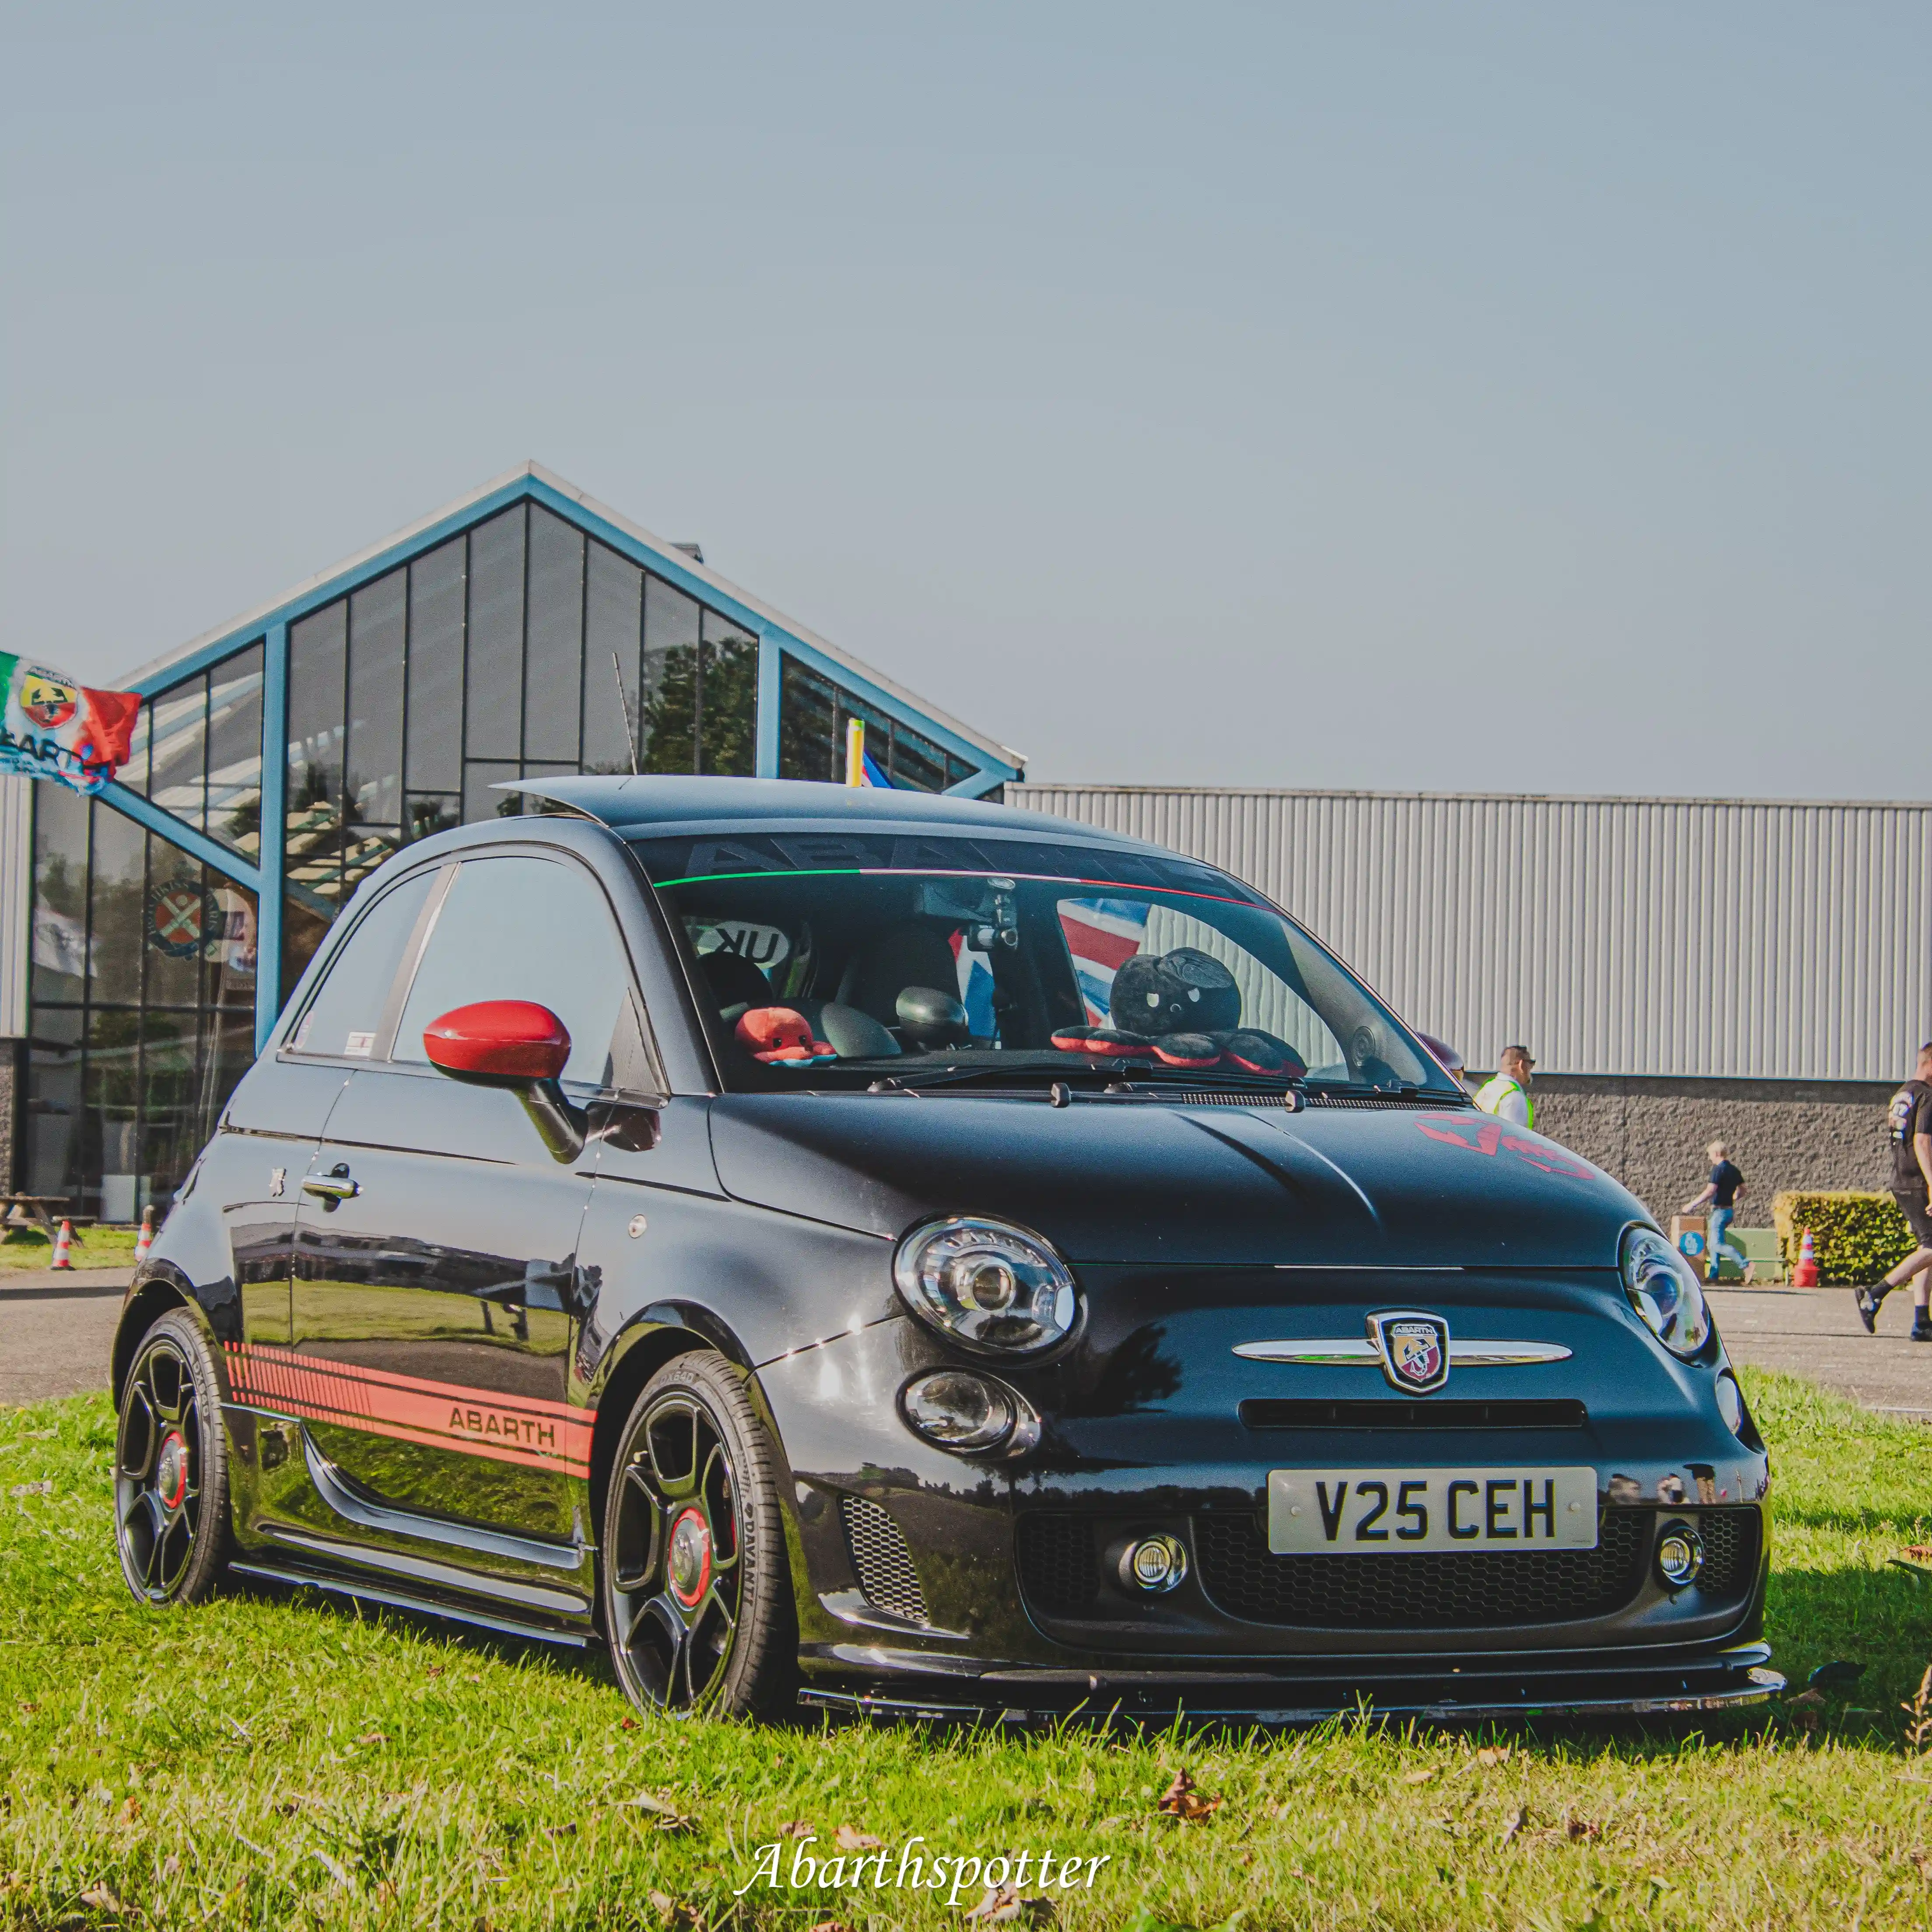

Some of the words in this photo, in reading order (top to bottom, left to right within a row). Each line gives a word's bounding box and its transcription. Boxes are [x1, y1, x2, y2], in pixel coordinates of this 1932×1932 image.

[449, 1407, 556, 1447] ABARTH
[1316, 1481, 1429, 1541] V25
[1448, 1478, 1555, 1540] CEH
[744, 1520, 756, 1607] DAVANTI
